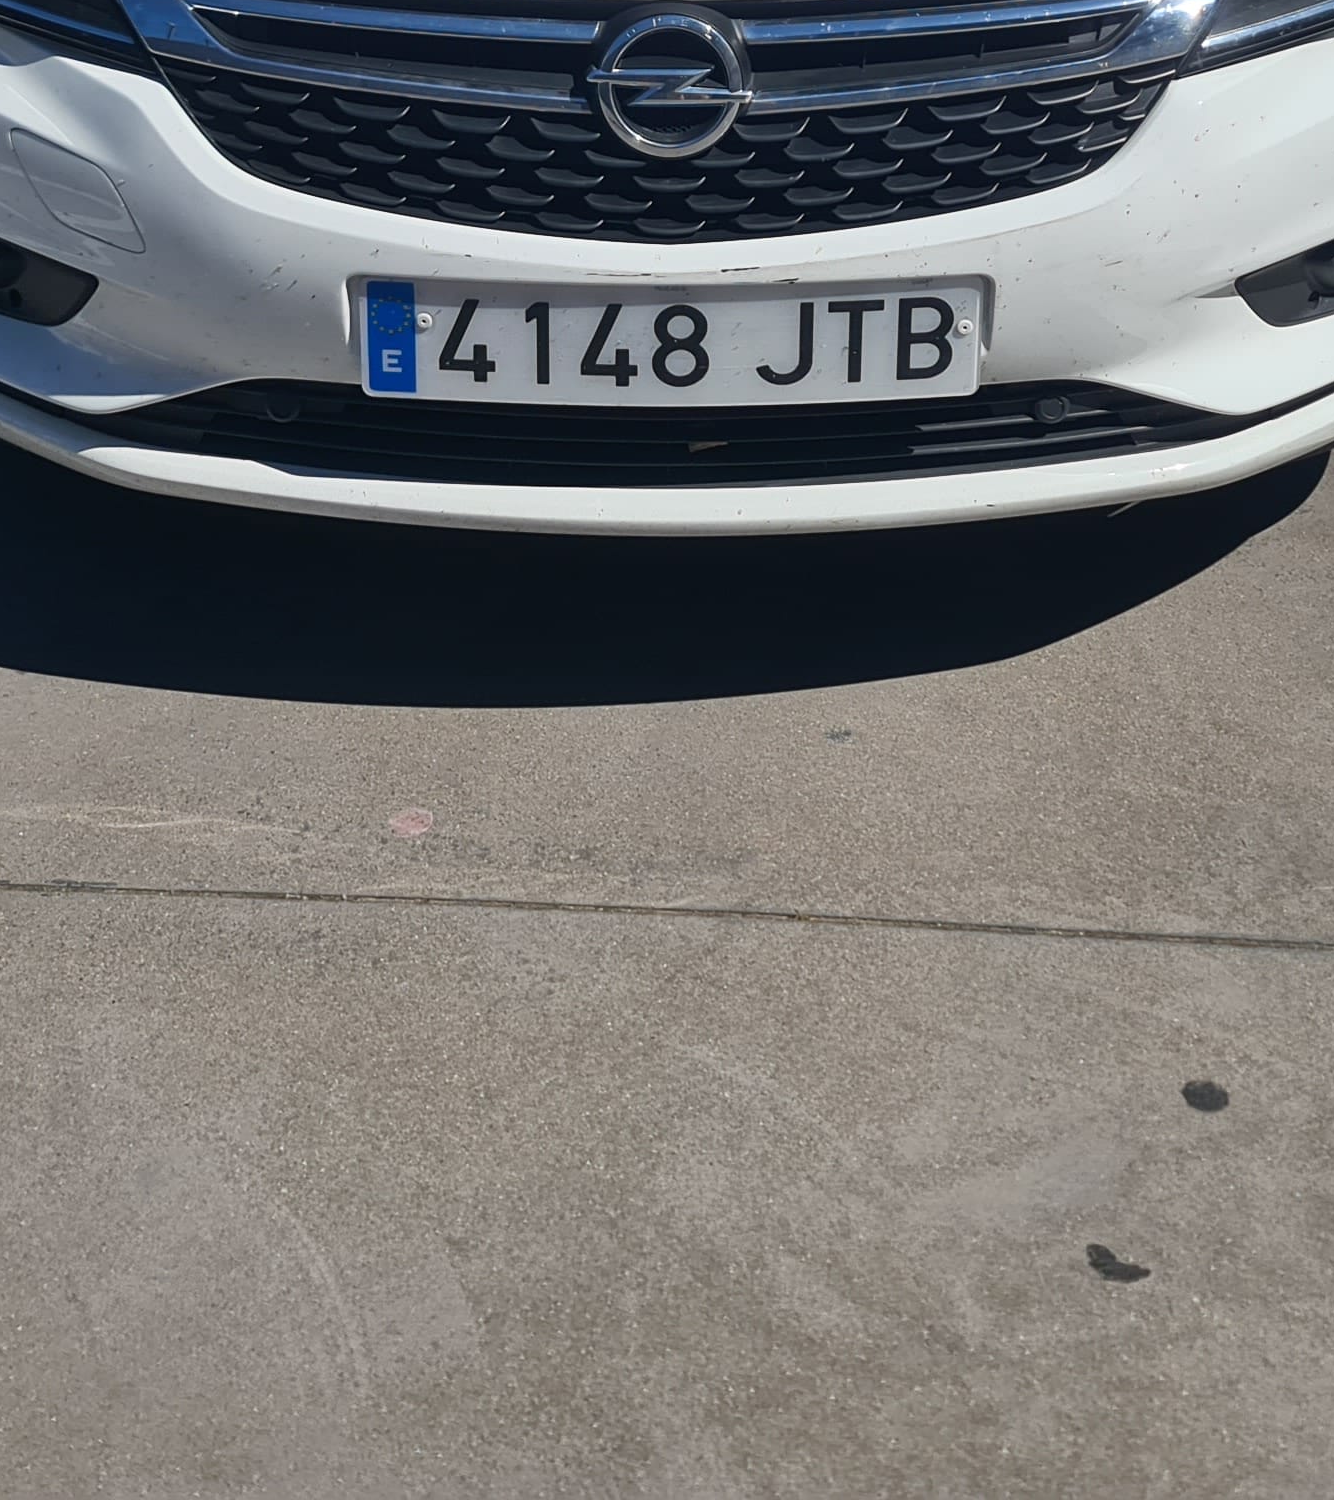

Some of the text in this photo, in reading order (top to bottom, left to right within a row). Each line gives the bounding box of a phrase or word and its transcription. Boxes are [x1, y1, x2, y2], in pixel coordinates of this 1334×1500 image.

[381, 296, 955, 388] E 4148 JTB
